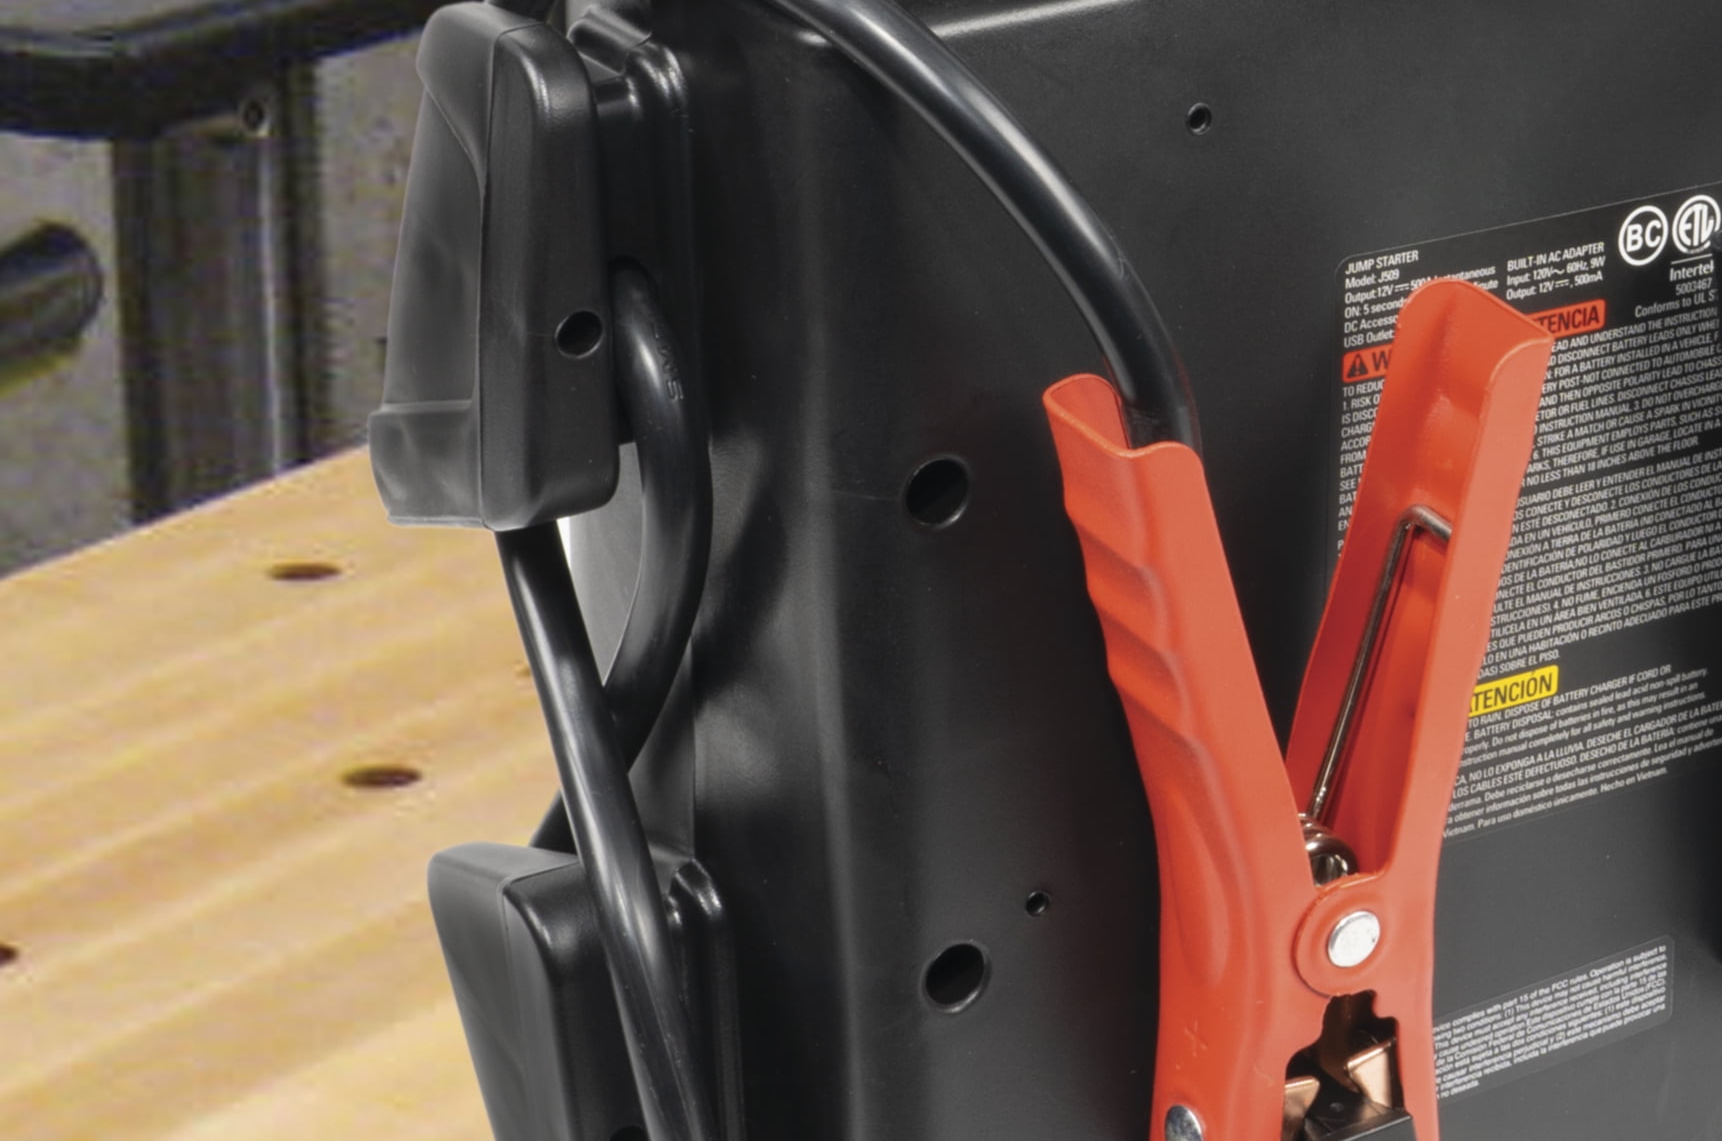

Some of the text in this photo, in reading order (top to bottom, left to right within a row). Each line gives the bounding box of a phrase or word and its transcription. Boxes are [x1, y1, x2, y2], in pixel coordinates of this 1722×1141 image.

[1626, 220, 1660, 252] BC
[1345, 250, 1418, 275] JUMP STARTER
[1506, 272, 1530, 287] Input:
[1590, 256, 1604, 268] 9W
[1507, 242, 1604, 271] BUILT-IN AC ADAPTER
[1345, 269, 1399, 289] Model: J509
[1506, 285, 1536, 301] Output:
[1675, 278, 1712, 295] 5003467
[1344, 307, 1360, 319] ON:
[1363, 304, 1369, 314] 5
[1634, 292, 1705, 318] Conforms to UL
[1343, 335, 1363, 347] USB
[1344, 322, 1357, 333] DC
[1551, 339, 1568, 352] EAD
[1569, 335, 1588, 348] AND
[1590, 322, 1646, 343] UNDERSTAND
[1648, 319, 1663, 331] THE
[1554, 365, 1570, 377] FOR
[1571, 363, 1578, 373] A
[1579, 355, 1614, 372] BATTERY
[1616, 345, 1660, 363] INSTALLED
[1661, 343, 1670, 353] IN
[1671, 341, 1678, 351] A
[1557, 343, 1609, 364] DISCONNECT
[1611, 335, 1647, 351] BATTERY
[1648, 329, 1674, 344] LEADS
[1675, 324, 1696, 337] ONLY
[1601, 360, 1650, 379] CONNECTED
[1651, 357, 1662, 367] TO
[1663, 345, 1715, 365] AUTOMOBILE
[1343, 379, 1384, 397] TO REDUC
[1539, 394, 1557, 407] AND
[1559, 388, 1580, 402] THEN
[1582, 379, 1621, 397] OPPOSITE
[1623, 370, 1660, 387] POLARITY
[1662, 365, 1682, 378] LEAD
[1684, 362, 1694, 373] TO
[1558, 405, 1569, 416] OR
[1570, 400, 1589, 413] FUEL
[1617, 381, 1667, 401] DISCONNECT
[1669, 373, 1704, 389] CHASSIS
[1351, 396, 1371, 409] RISK
[1539, 412, 1593, 433] INSTRUCTION
[1641, 397, 1653, 408] DO
[1655, 392, 1671, 405] NOT
[1341, 413, 1350, 424] IS
[1536, 431, 1565, 446] STRIKE
[1566, 429, 1572, 439] A
[1574, 422, 1604, 437] MATCH
[1605, 418, 1617, 430] OR
[1618, 411, 1644, 426] CAUSE
[1646, 410, 1652, 419] A
[1653, 403, 1679, 418] SPARK
[1681, 400, 1690, 411] IN
[1542, 445, 1560, 457] THIS
[1562, 433, 1609, 453] EQUIPMENT
[1611, 423, 1648, 440] EMPLOYS
[1679, 410, 1700, 424] SUCH
[1702, 407, 1712, 418] AS
[1601, 445, 1608, 456] IF
[1610, 441, 1624, 454] USE
[1626, 438, 1636, 449] IN
[1673, 422, 1702, 438] LOCATE
[1704, 419, 1713, 430] IN
[1340, 449, 1367, 464] FROM
[1526, 475, 1539, 486] NO
[1541, 470, 1561, 483] LESS
[1563, 464, 1585, 477] THAN
[1597, 454, 1626, 470] INCHES
[1628, 446, 1654, 461] ABOVE
[1657, 442, 1671, 454] THE
[1339, 478, 1356, 491] SEE
[1517, 453, 1702, 508] SUARIO DEBE LEER Y ENTENDER EL MANUAL DE
[1528, 655, 1537, 666] EL
[1468, 717, 1478, 729] TO
[1504, 700, 1539, 719] DISPOSE
[1541, 697, 1551, 708] OF
[1553, 688, 1588, 705] BATTERY
[1590, 677, 1627, 695] CHARGER
[1628, 674, 1635, 684] IF
[1636, 668, 1658, 682] CORD
[1659, 664, 1671, 676] OR
[1471, 672, 1552, 711] TENCIÓN
[1473, 721, 1510, 740] BATTERY
[1555, 700, 1587, 716] contains
[1551, 978, 1568, 992] FCC
